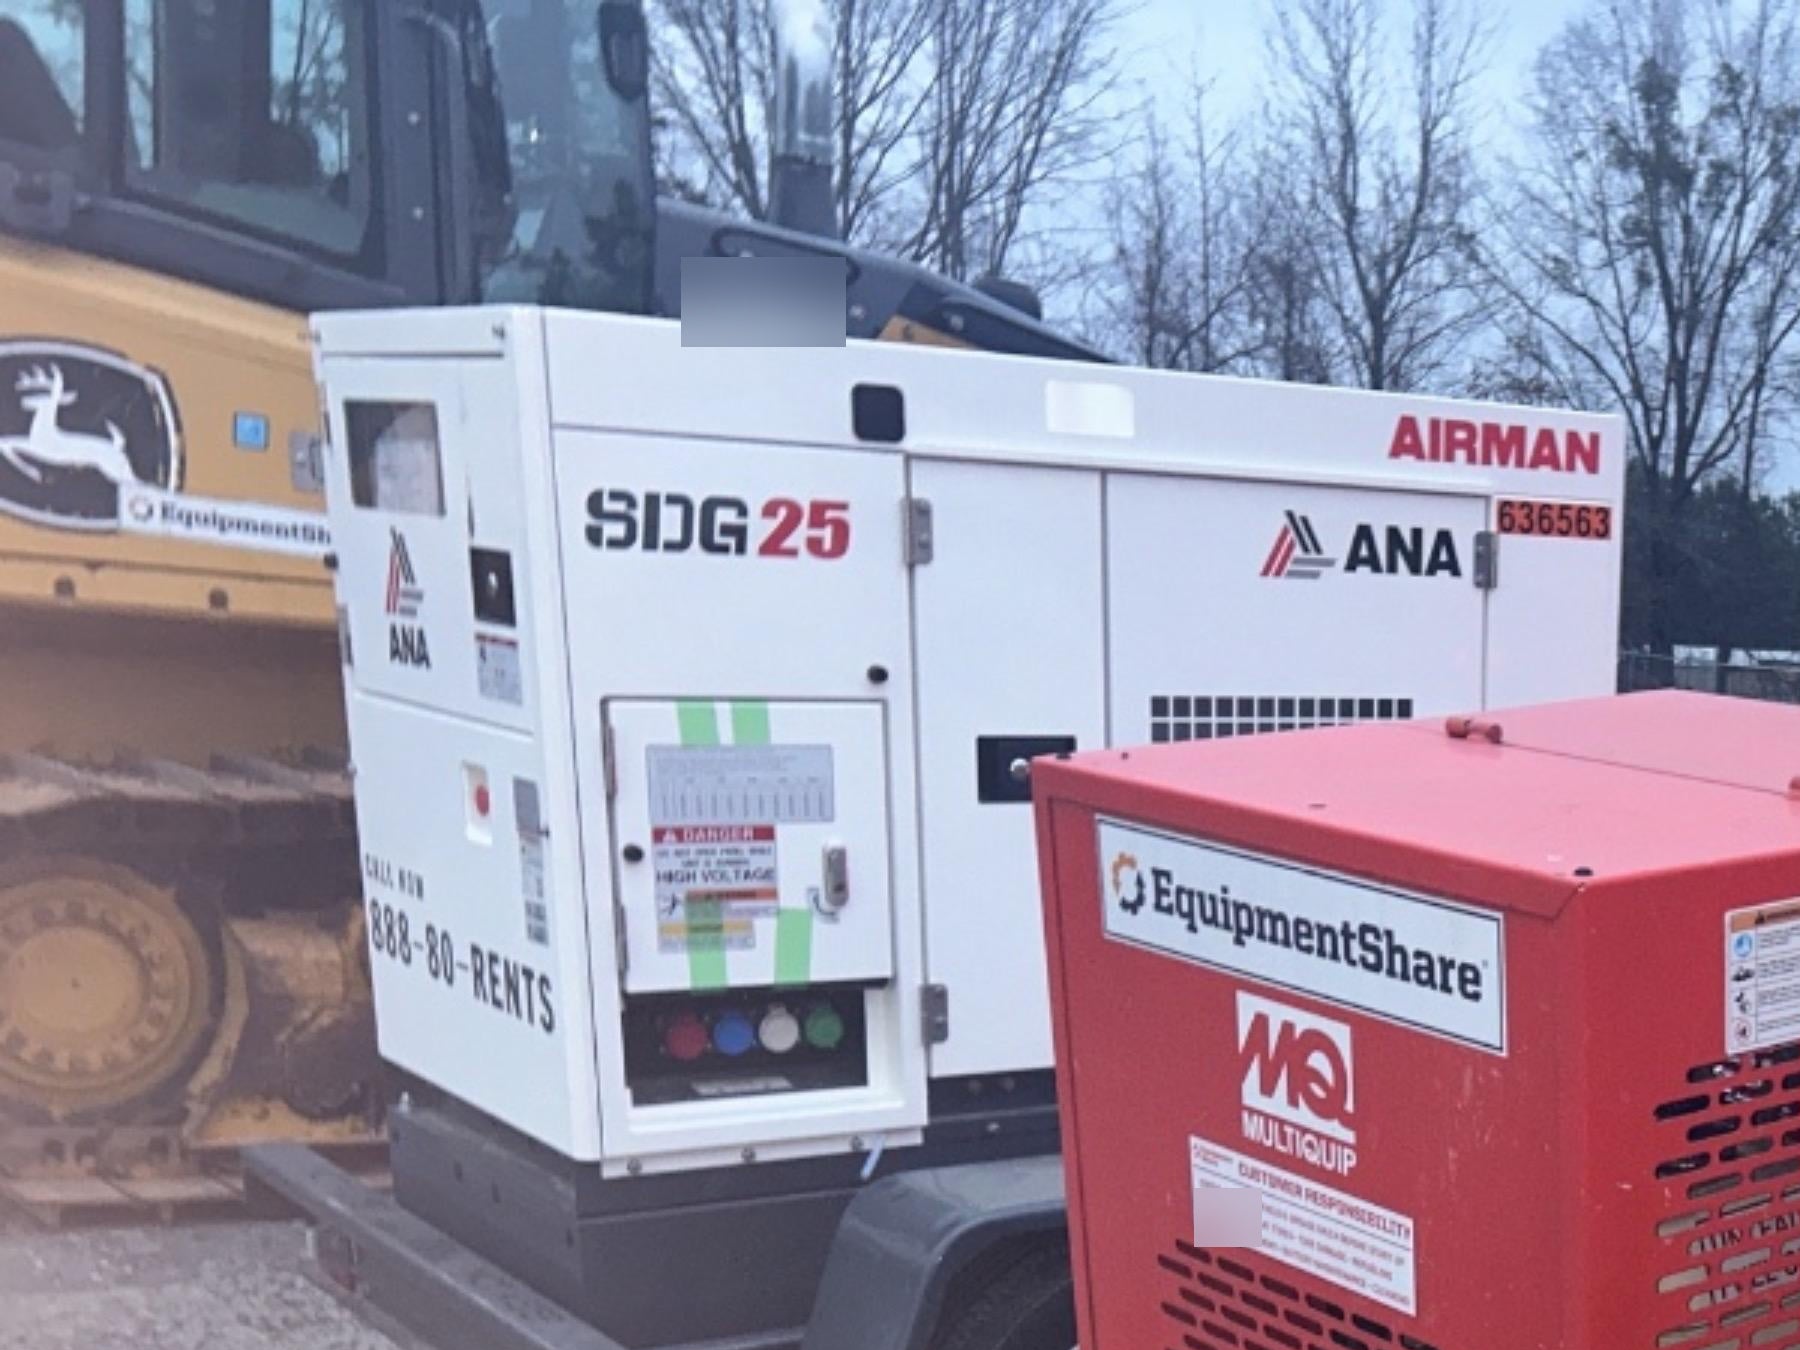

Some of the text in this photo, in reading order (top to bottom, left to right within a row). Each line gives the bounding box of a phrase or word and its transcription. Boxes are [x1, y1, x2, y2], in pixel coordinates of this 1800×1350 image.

[1388, 414, 1600, 475] AIRMAN
[1344, 523, 1463, 578] ANA
[1497, 501, 1611, 539] 636563
[390, 622, 432, 670] ANA
[683, 825, 754, 843] DANGER
[656, 866, 776, 884] HIGH VOLTAGE
[1151, 865, 1483, 1003] EquipmentShare
[370, 897, 555, 1034] 888-80-RENTS
[1237, 1004, 1357, 1135] MQ
[1240, 1109, 1358, 1178] MULTIQUIP
[1237, 1160, 1304, 1200] CUSTOMER
[1303, 1183, 1412, 1240] RESPONSIBILITY
